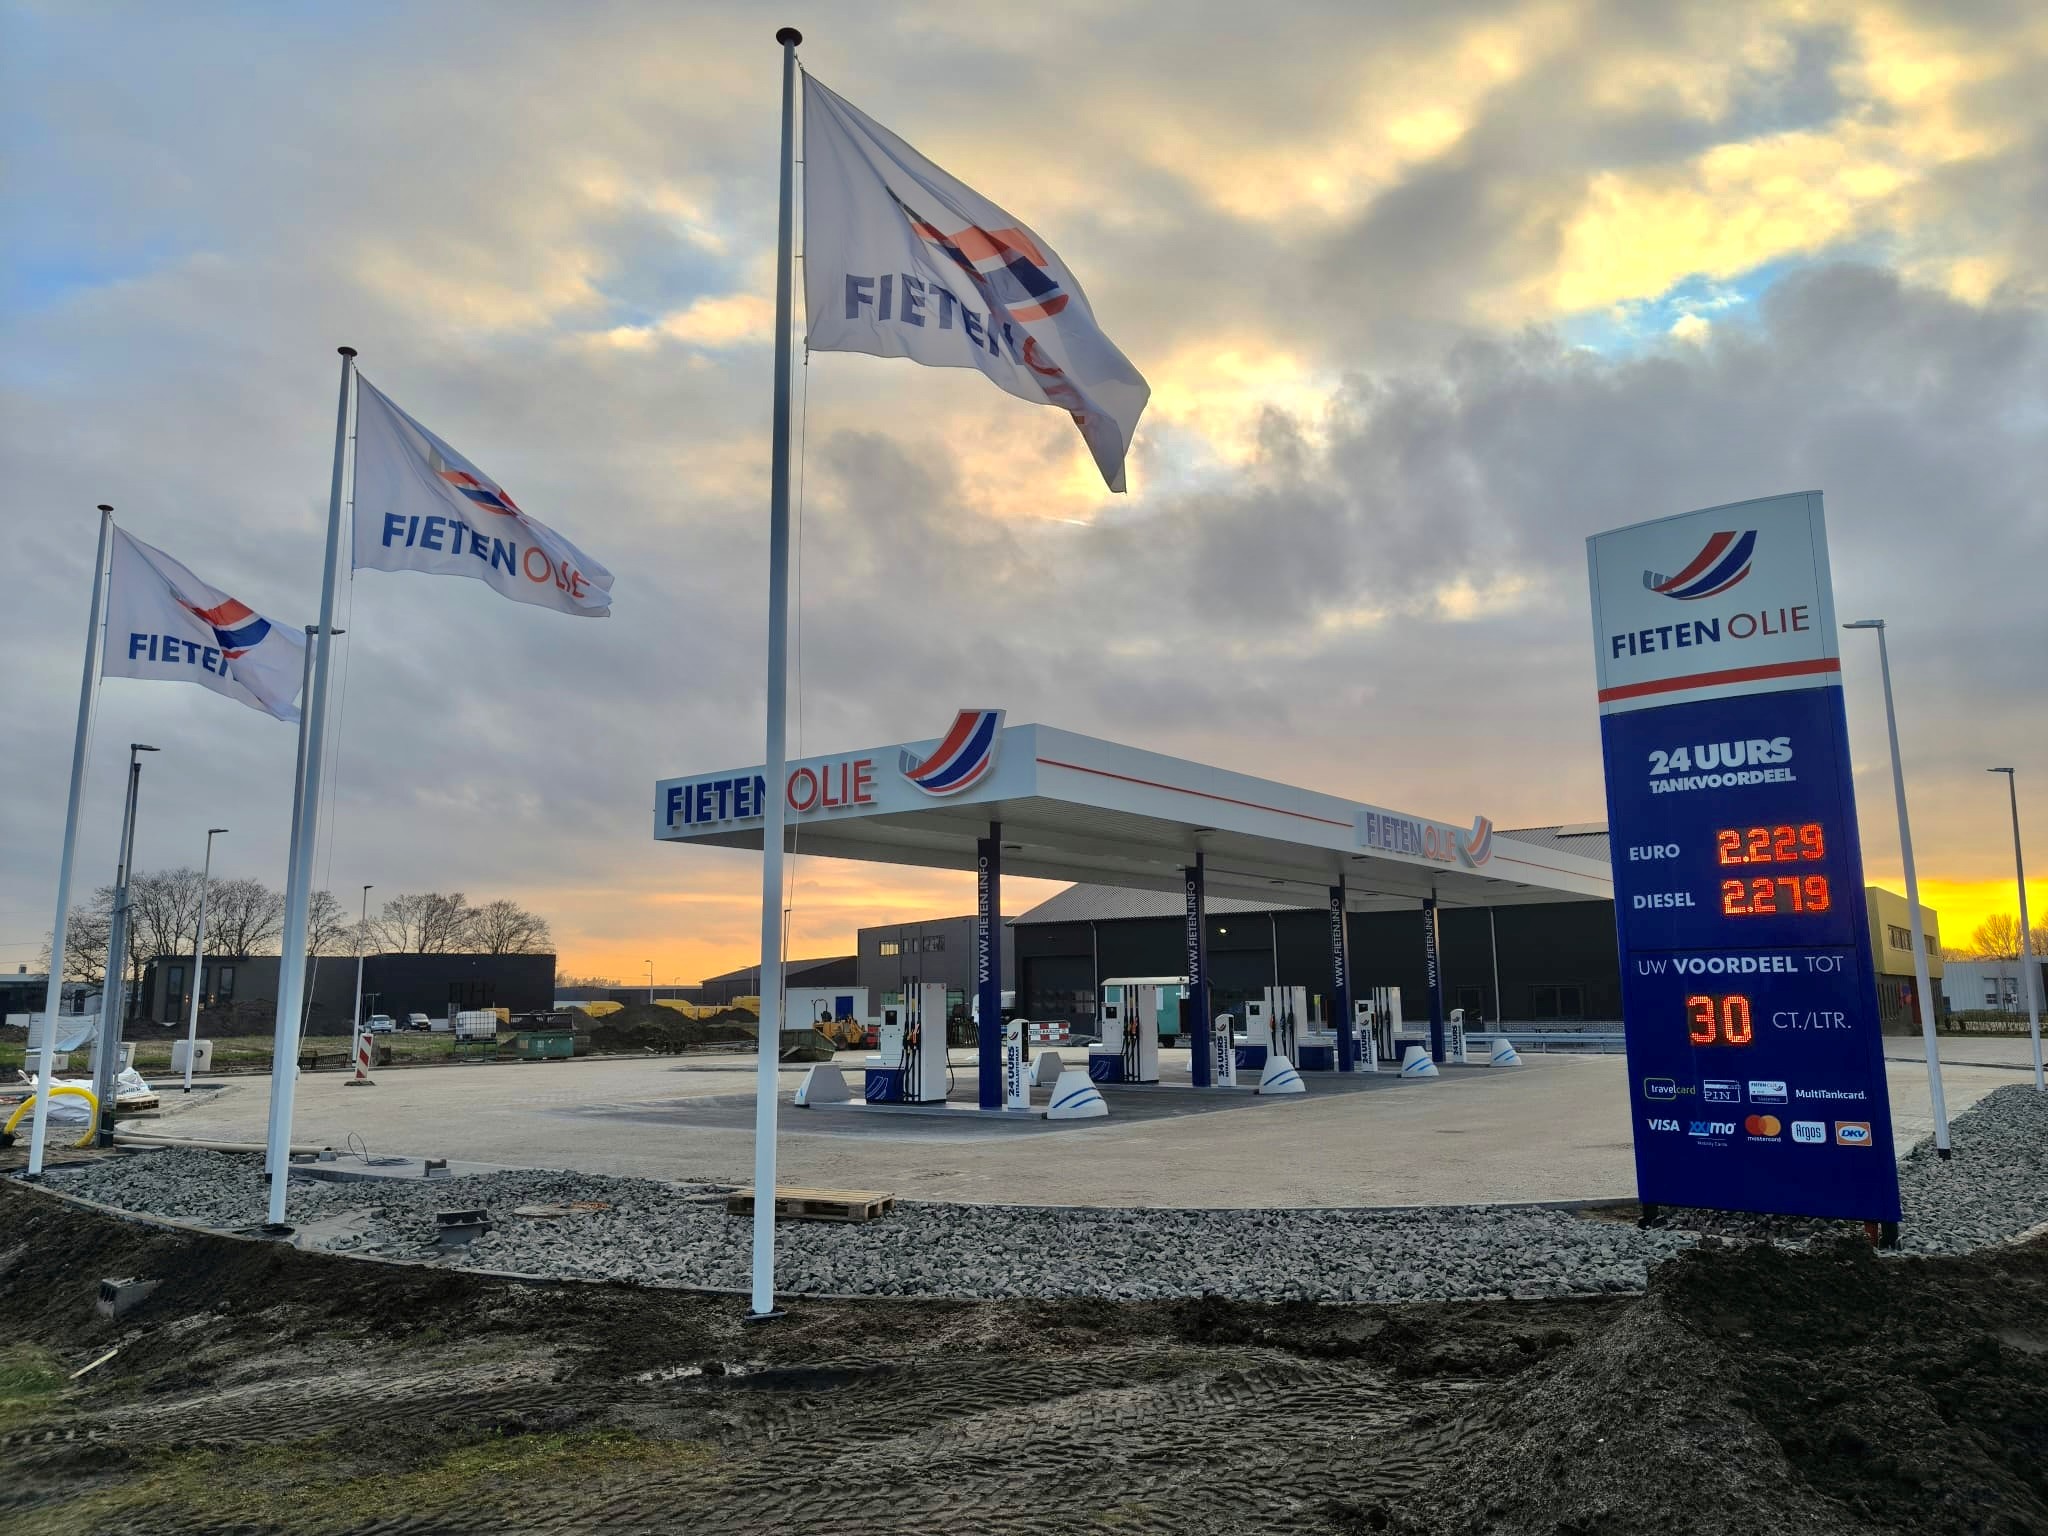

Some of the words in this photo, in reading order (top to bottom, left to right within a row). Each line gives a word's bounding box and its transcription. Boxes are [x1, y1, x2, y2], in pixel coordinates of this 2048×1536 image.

[382, 512, 516, 577] FIETEN
[1612, 618, 1720, 659] FIETEN
[1727, 605, 1810, 639] OLIE
[1648, 750, 1692, 776] 24
[1694, 737, 1793, 770] UURS
[787, 759, 873, 812] OLIE
[1650, 768, 1796, 794] TANKVOORDEEL
[1366, 811, 1422, 853] FIETEN
[1424, 825, 1457, 861] OLIE
[1629, 843, 1681, 861] EURO
[1717, 823, 1825, 865] 2.229
[1633, 892, 1696, 910] DIESEL
[1721, 875, 1831, 915] 2.279
[979, 856, 990, 984] WWW.FIETEN.INFO
[1187, 881, 1199, 985] WWW.FIETEN.INFO
[1638, 960, 1666, 976] UW
[1672, 956, 1798, 975] VOORDEEL
[1804, 955, 1844, 972] TOT
[1687, 995, 1752, 1044] 30
[1772, 1012, 1852, 1029] CT./LTR.
[1008, 1081, 1015, 1097] 24
[1651, 1084, 1696, 1095] travelcard
[1703, 1091, 1731, 1100] PIN
[1646, 1119, 1681, 1132] VISA
[1795, 1123, 1822, 1141] Argos
[1841, 1129, 1866, 1137] DKV
